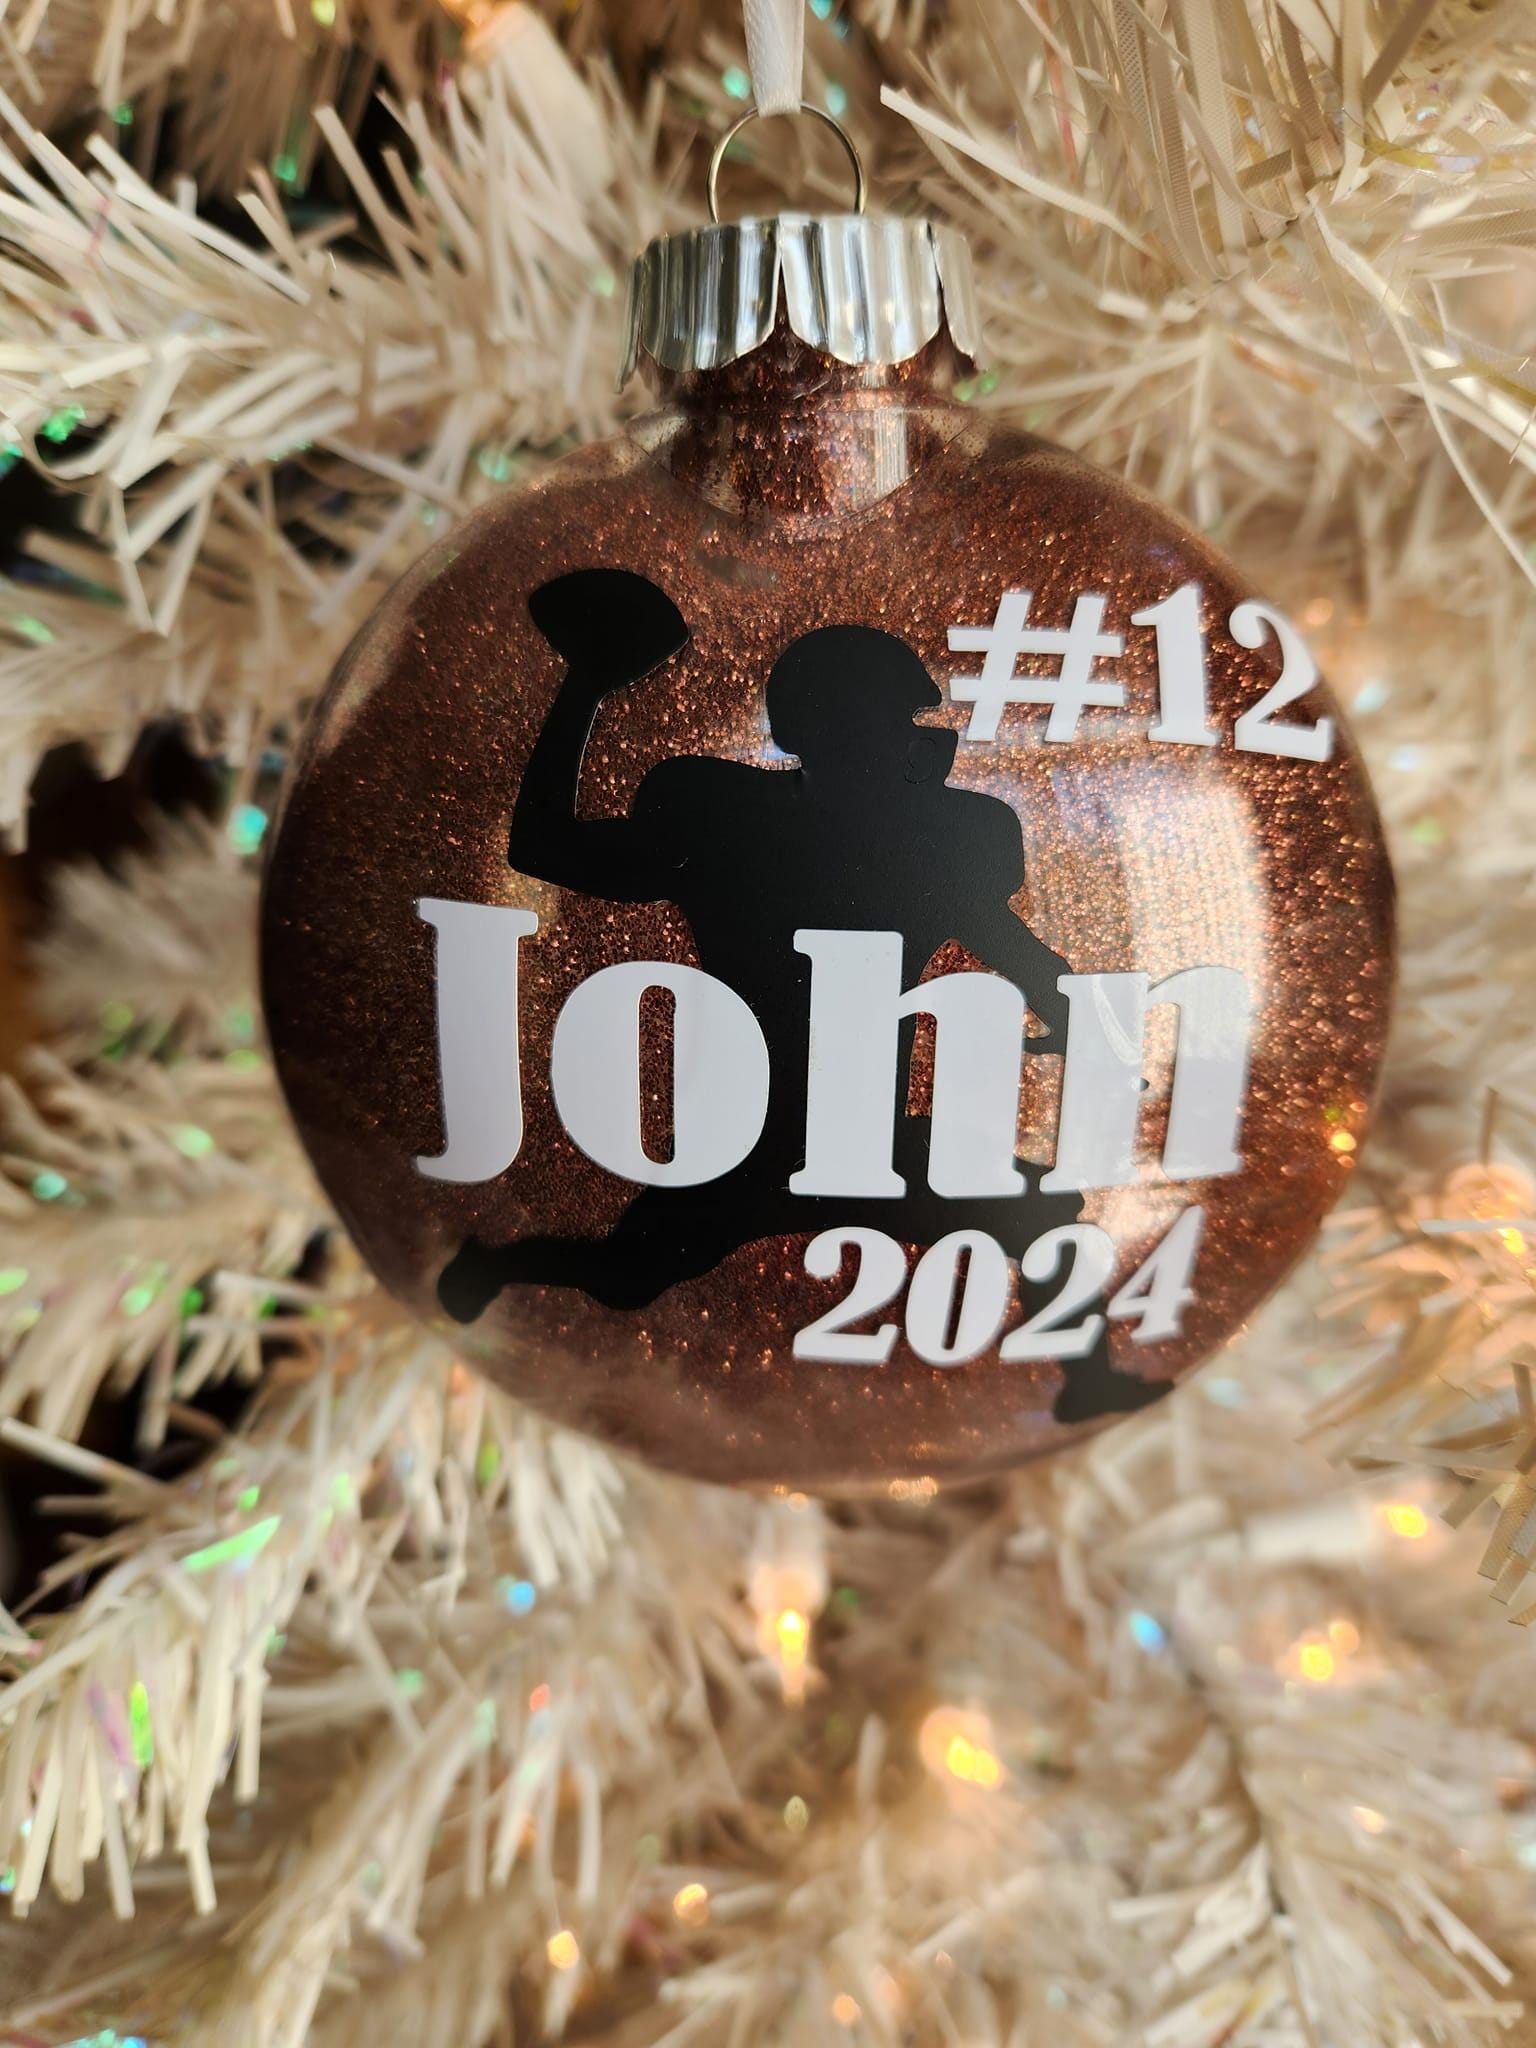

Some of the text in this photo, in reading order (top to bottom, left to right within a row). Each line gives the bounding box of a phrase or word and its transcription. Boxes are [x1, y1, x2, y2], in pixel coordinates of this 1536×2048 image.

[946, 583, 1333, 763] #12
[414, 897, 1254, 1198] John
[792, 1204, 1206, 1368] 2024
